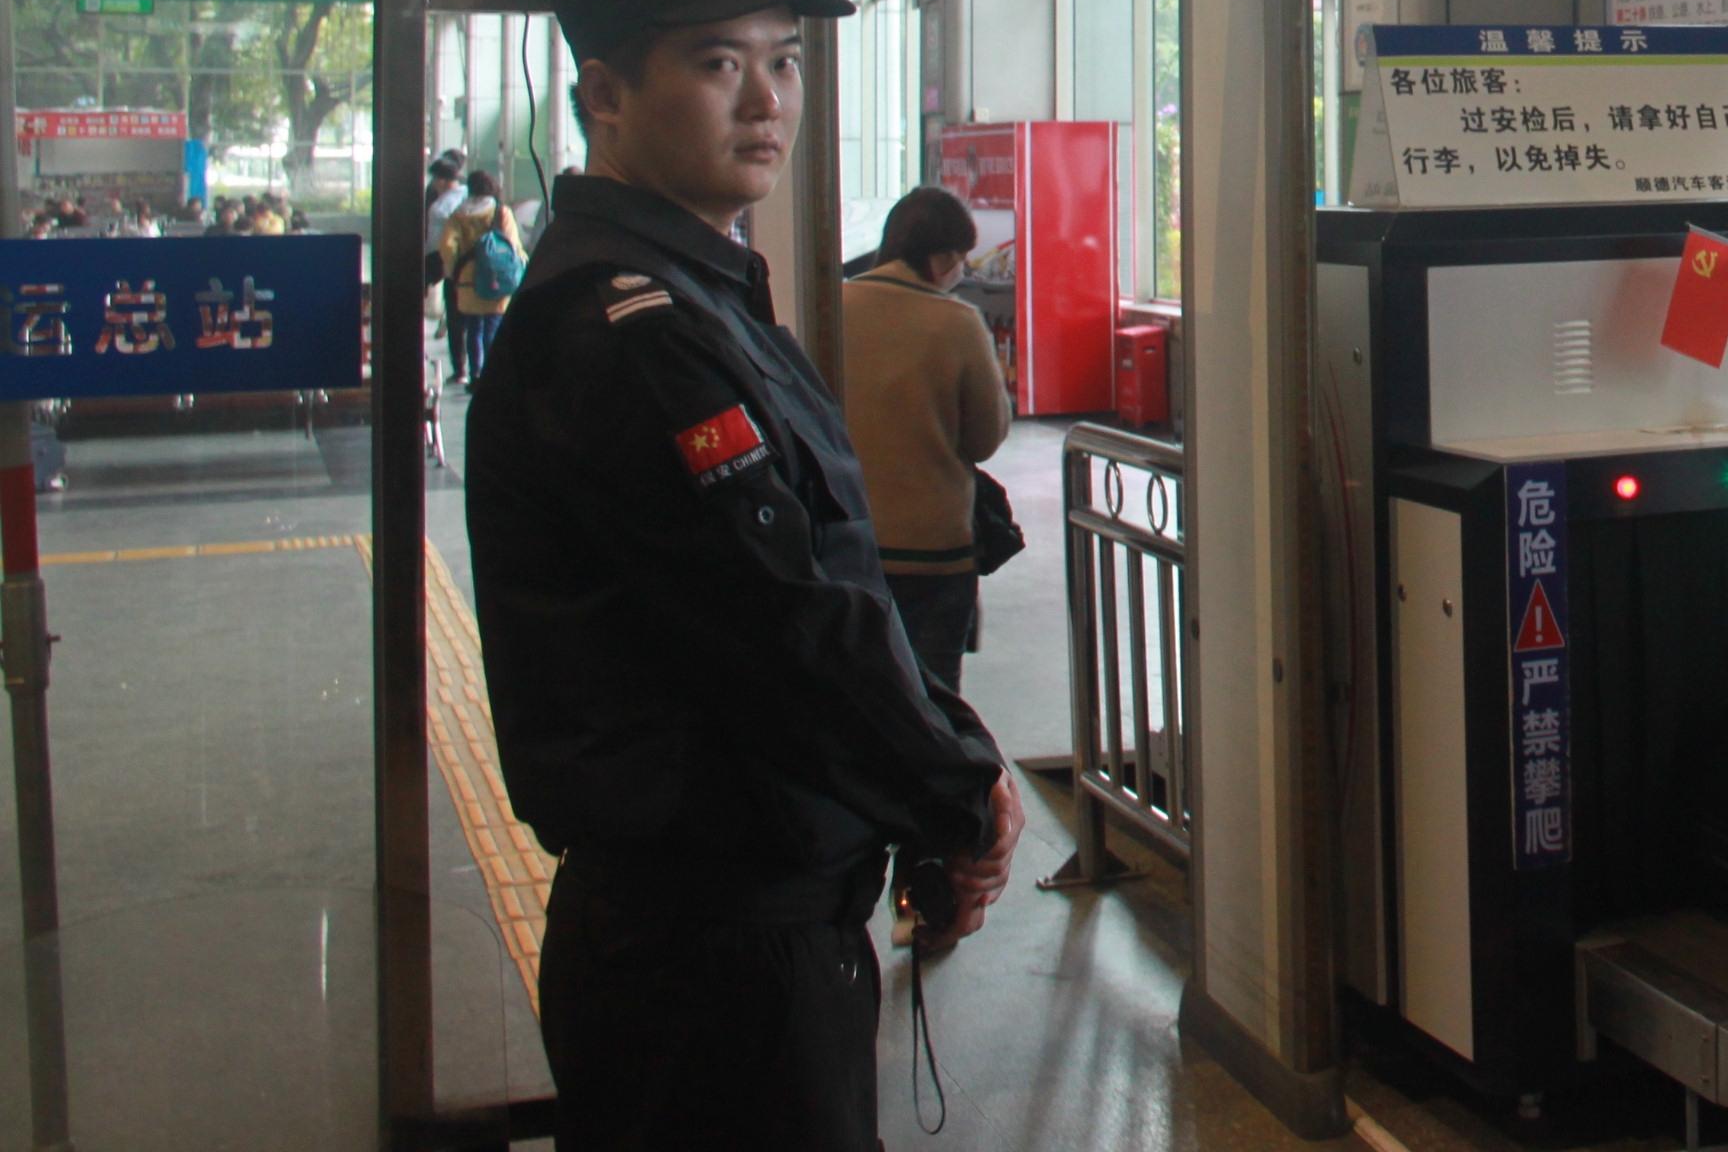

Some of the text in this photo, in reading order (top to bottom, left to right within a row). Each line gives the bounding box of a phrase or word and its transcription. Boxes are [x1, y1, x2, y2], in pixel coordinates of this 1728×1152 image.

[1479, 29, 1648, 53] 温馨提示
[1391, 67, 1522, 96] 各位旅客：
[1403, 146, 1627, 175] 行李，以免掉失。
[1517, 479, 1557, 578] 危险
[1521, 658, 1563, 854] 严禁攀爬
